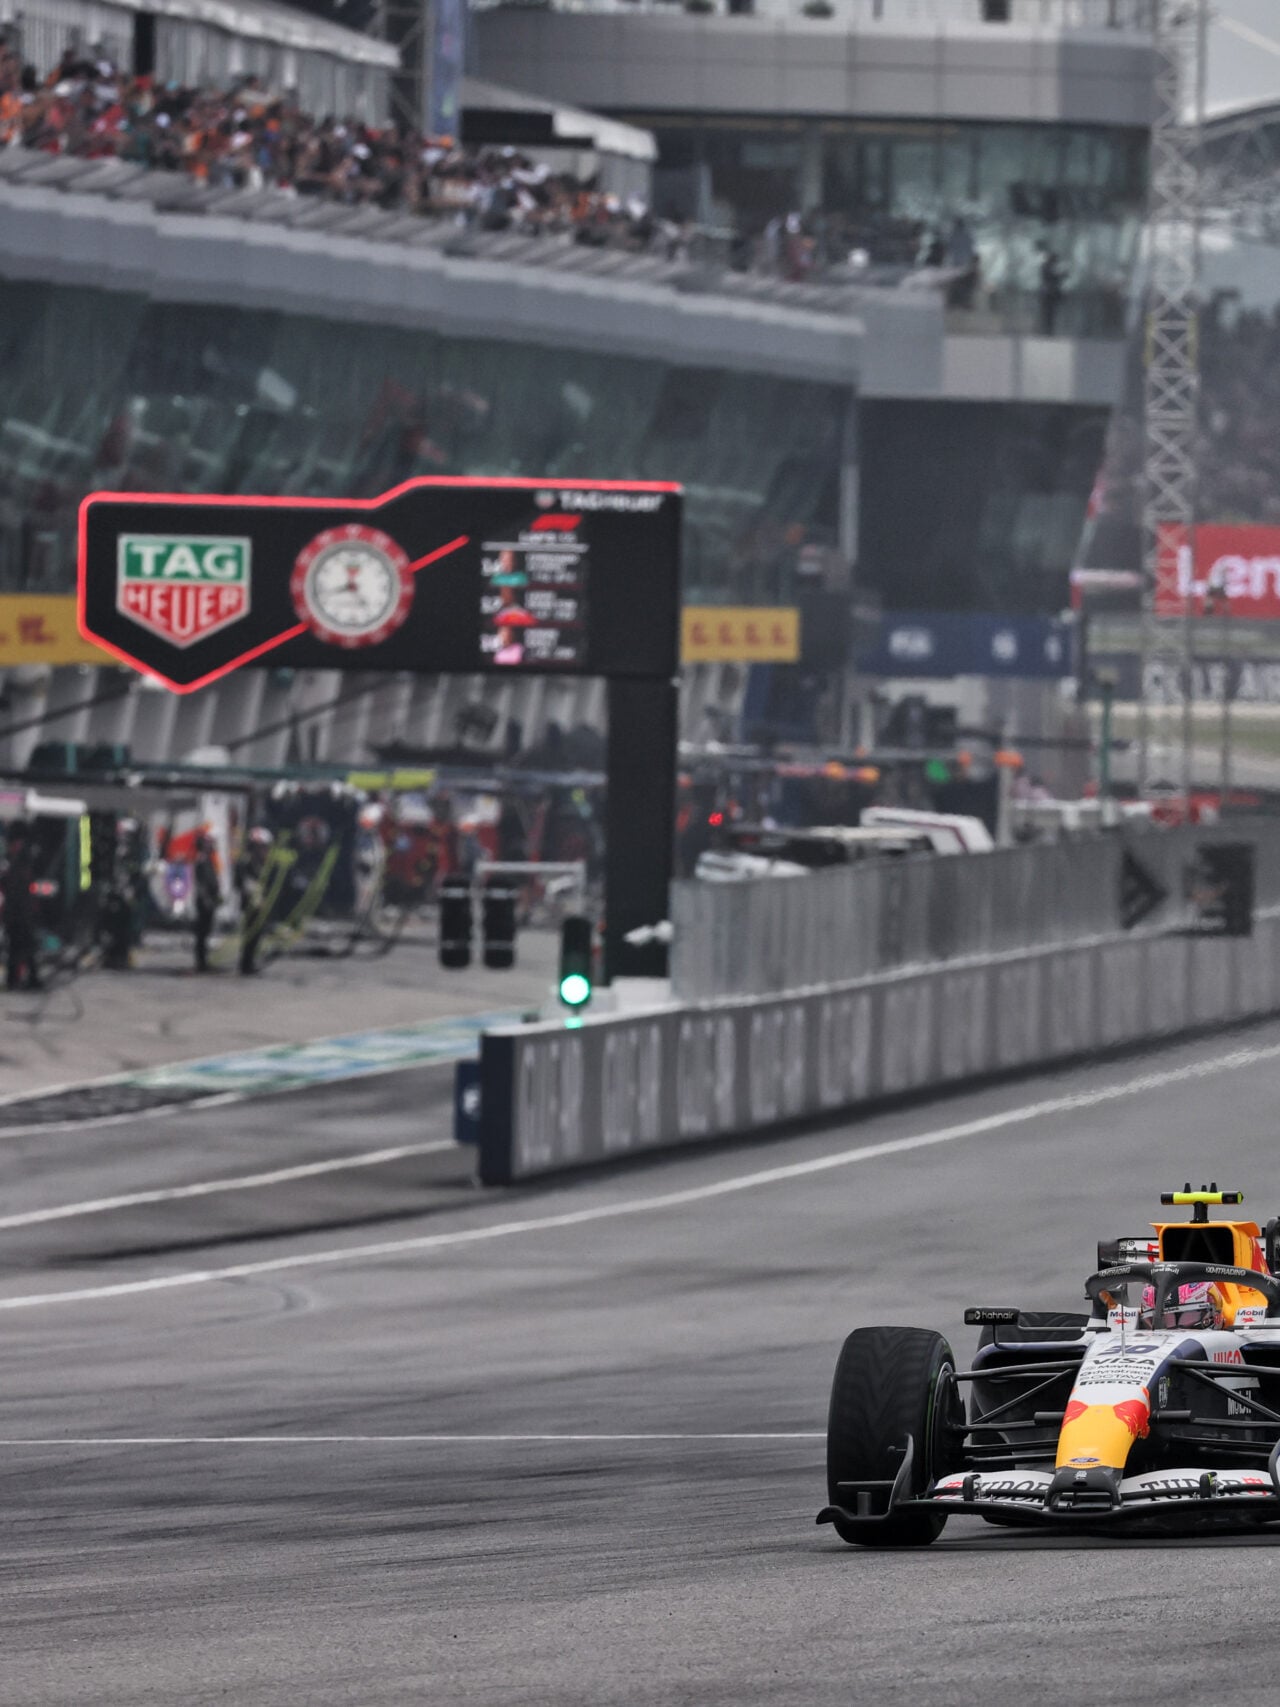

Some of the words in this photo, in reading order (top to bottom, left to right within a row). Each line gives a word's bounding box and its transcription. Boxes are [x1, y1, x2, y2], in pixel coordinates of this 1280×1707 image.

[129, 545, 238, 578] TAG
[125, 585, 239, 636] HEUER
[982, 1310, 1015, 1319] hahnair
[1109, 1310, 1137, 1319] Mobil
[1236, 1309, 1264, 1318] Mobil
[1093, 1357, 1155, 1366] VISA
[1213, 1349, 1242, 1364] HUGO
[1140, 1478, 1243, 1502] TUDR
